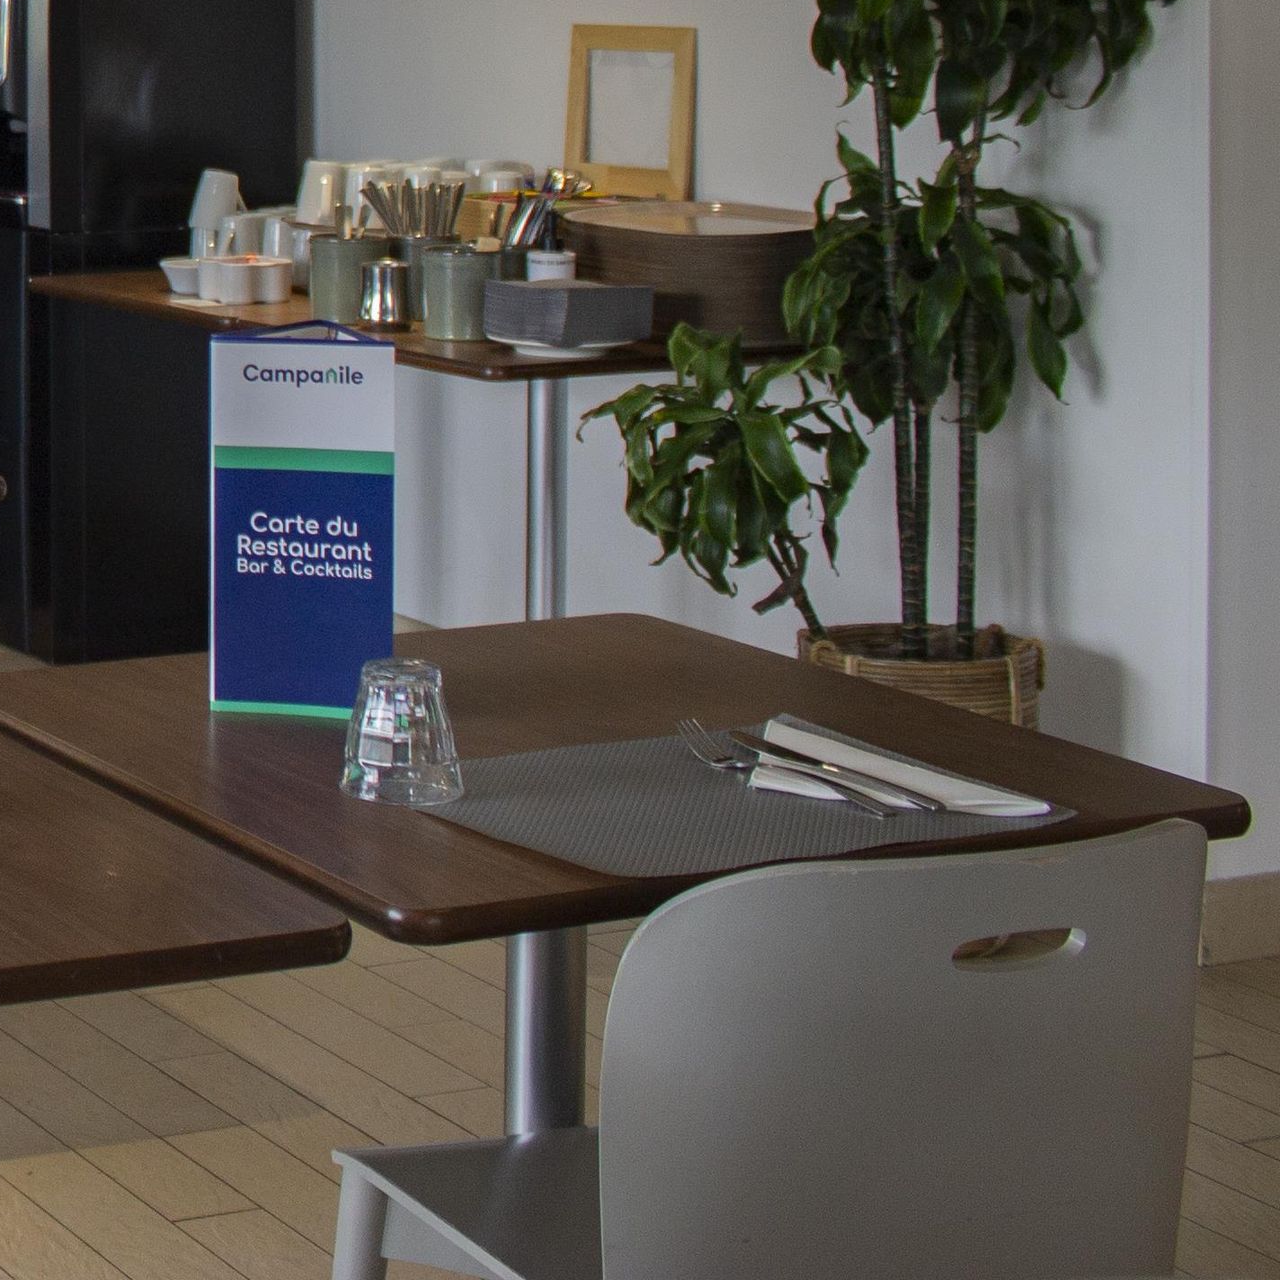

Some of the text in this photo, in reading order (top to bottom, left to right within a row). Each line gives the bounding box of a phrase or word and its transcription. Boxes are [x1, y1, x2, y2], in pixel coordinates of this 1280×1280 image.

[242, 363, 364, 388] Campanile
[249, 511, 358, 537] Carte du
[237, 533, 373, 562] Restaurant
[236, 557, 373, 580] Bar & Cocktails
